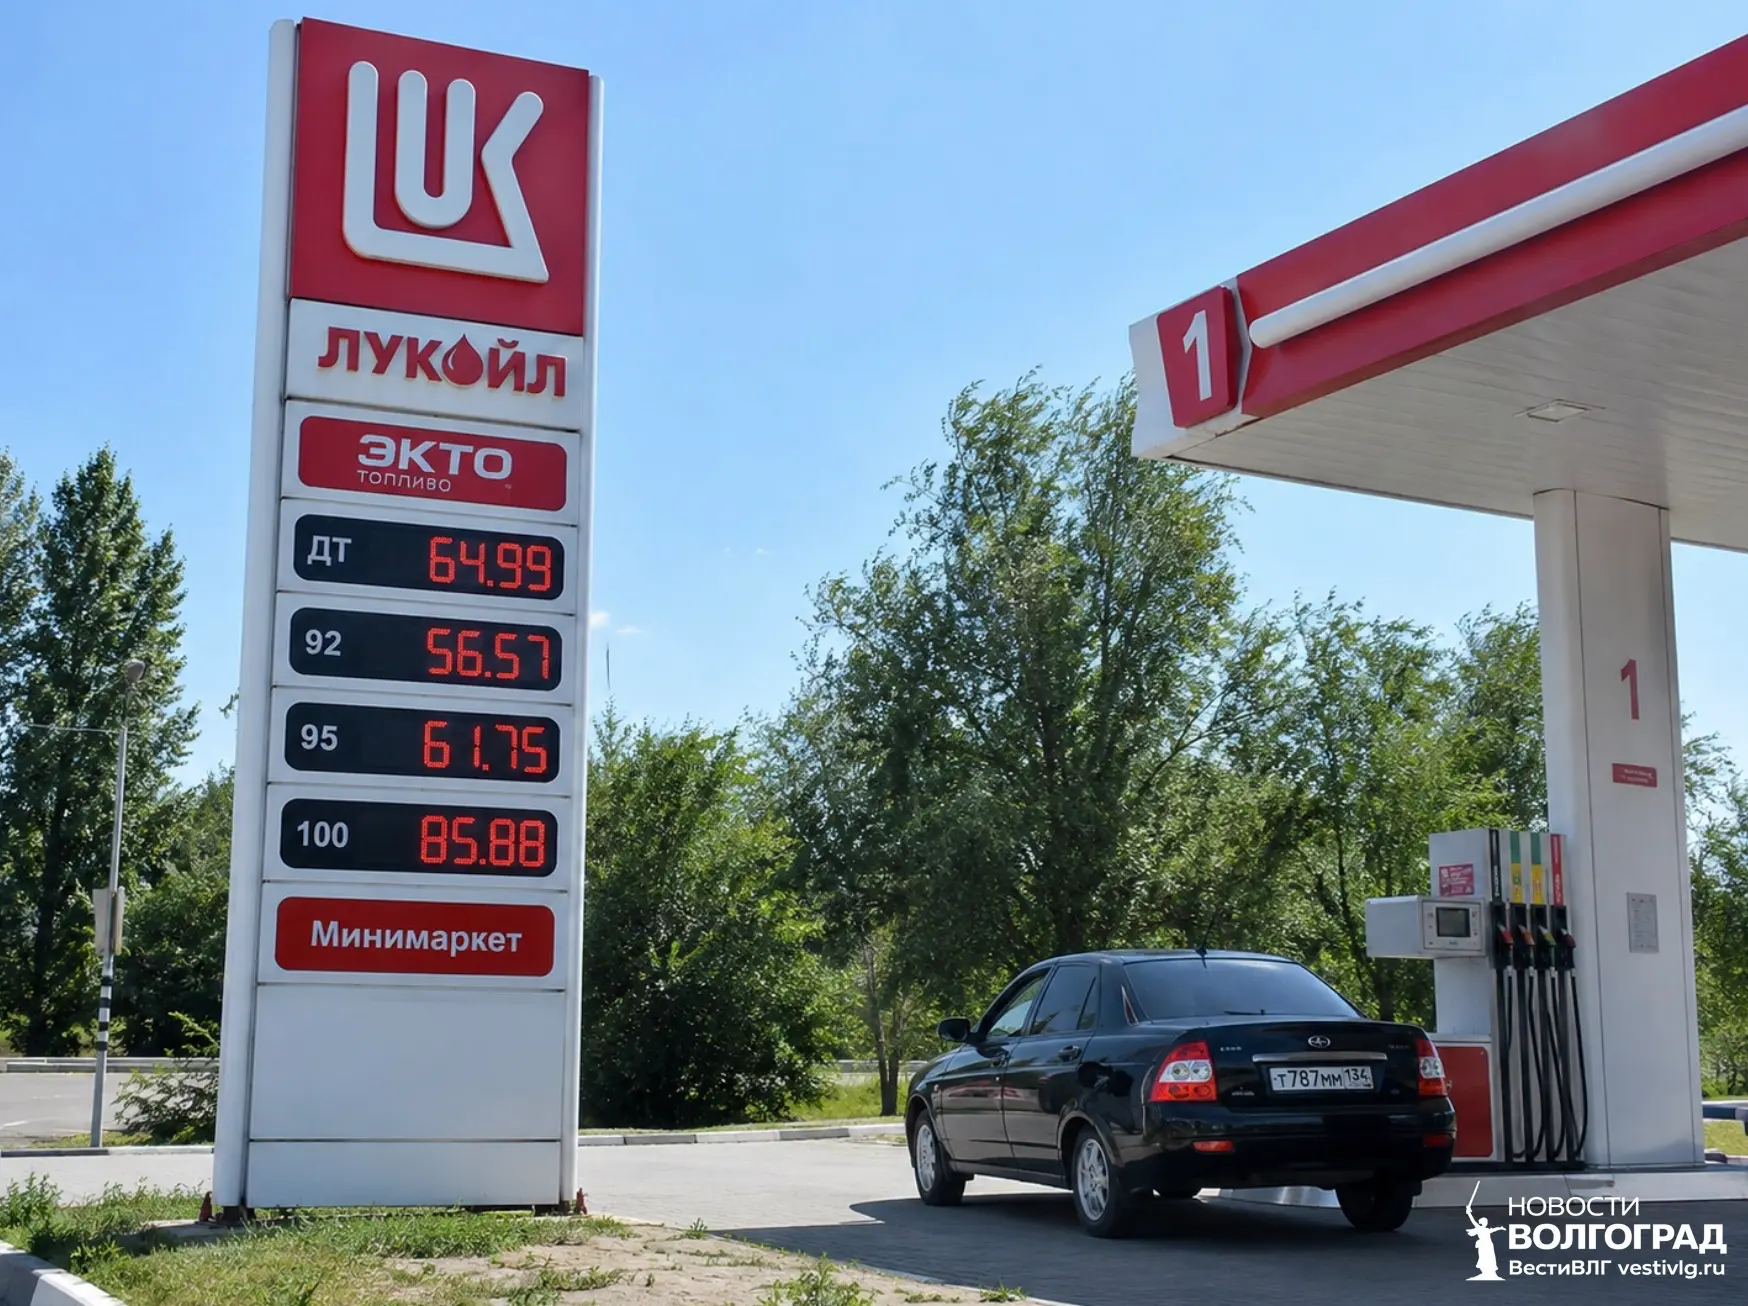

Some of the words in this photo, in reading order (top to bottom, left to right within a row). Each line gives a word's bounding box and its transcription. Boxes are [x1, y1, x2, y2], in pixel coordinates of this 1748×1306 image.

[1182, 309, 1212, 402] 1
[358, 434, 513, 480] ЭКТО
[307, 535, 352, 566] ДТ
[428, 536, 552, 591] 64.99
[304, 629, 342, 656] 92
[426, 628, 550, 680] 56.57
[1620, 659, 1640, 720] 1
[300, 724, 339, 751] 95
[423, 720, 547, 773] 61.75
[296, 821, 349, 848] 100
[420, 815, 546, 868] 85.88
[310, 920, 523, 956] Минимаркет
